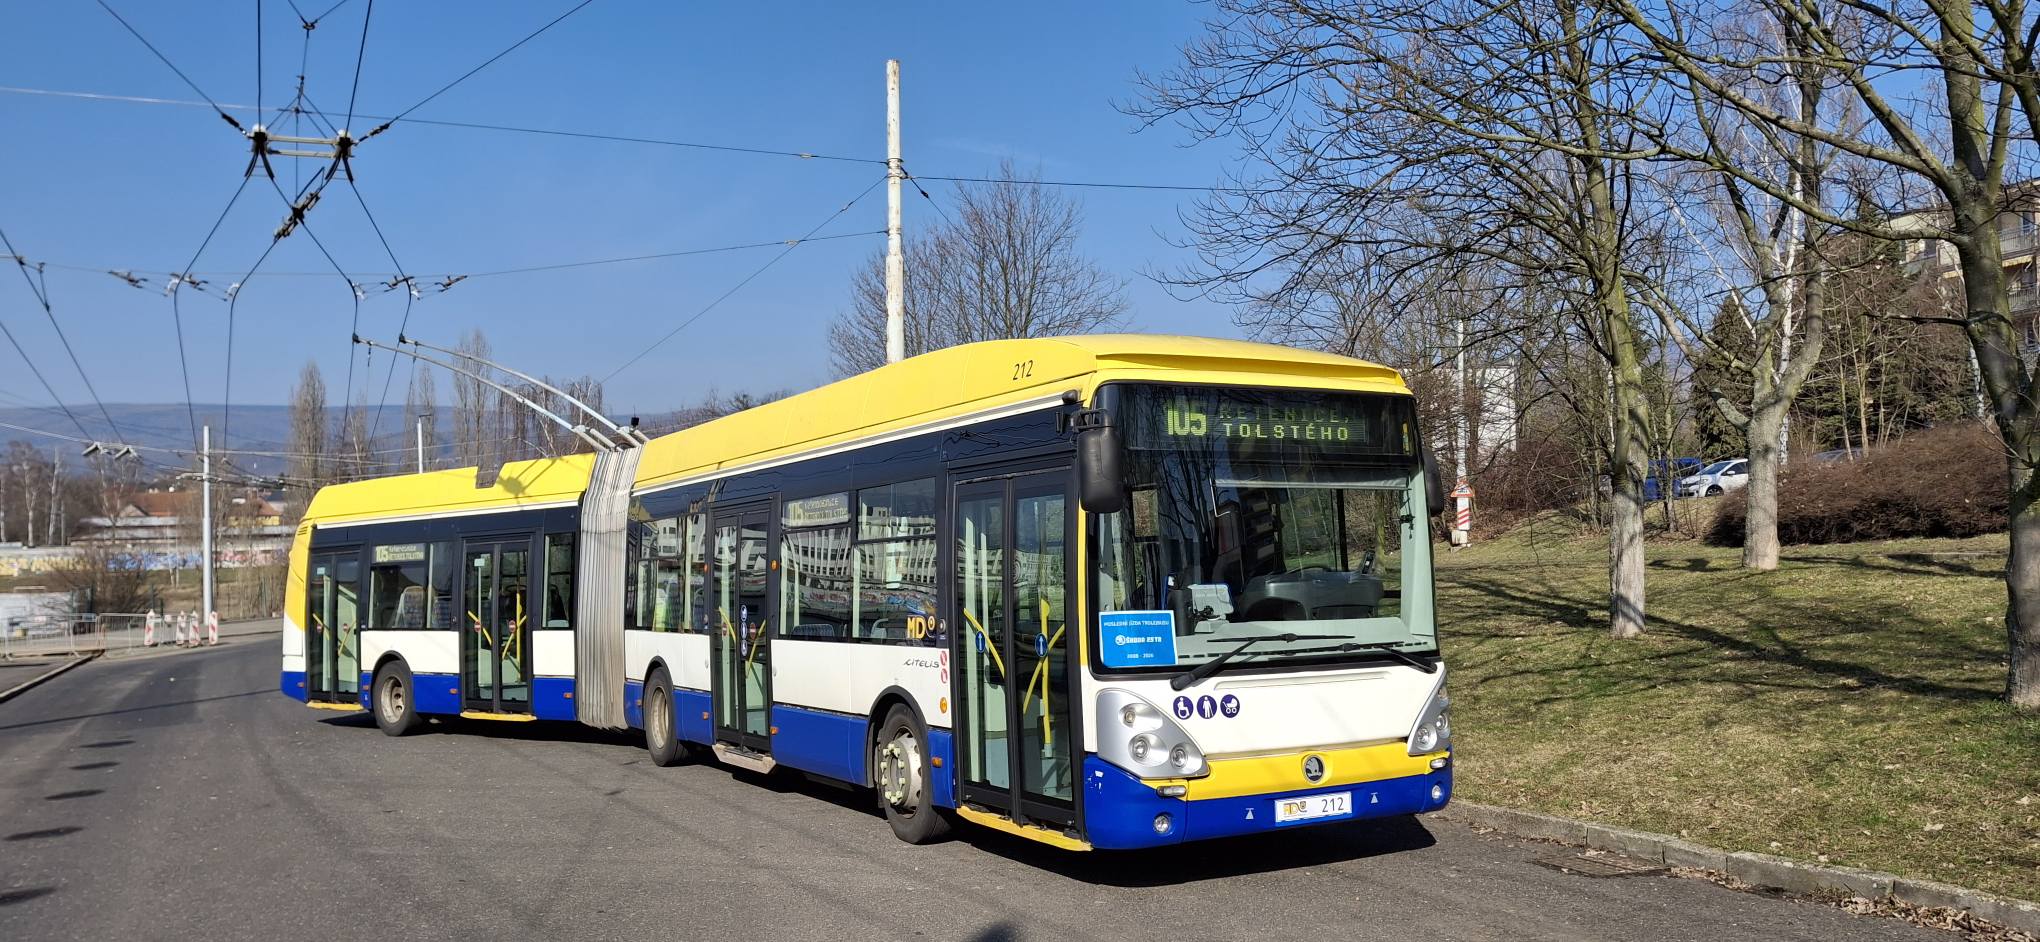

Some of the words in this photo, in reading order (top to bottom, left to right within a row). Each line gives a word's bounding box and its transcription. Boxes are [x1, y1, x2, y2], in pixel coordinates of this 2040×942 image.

[1013, 360, 1034, 380] 212
[1167, 397, 1207, 437] 105
[1223, 422, 1349, 441] TOLSTÉHO
[376, 545, 389, 562] 105
[904, 658, 940, 668] CITELIS
[1321, 797, 1345, 813] 212
